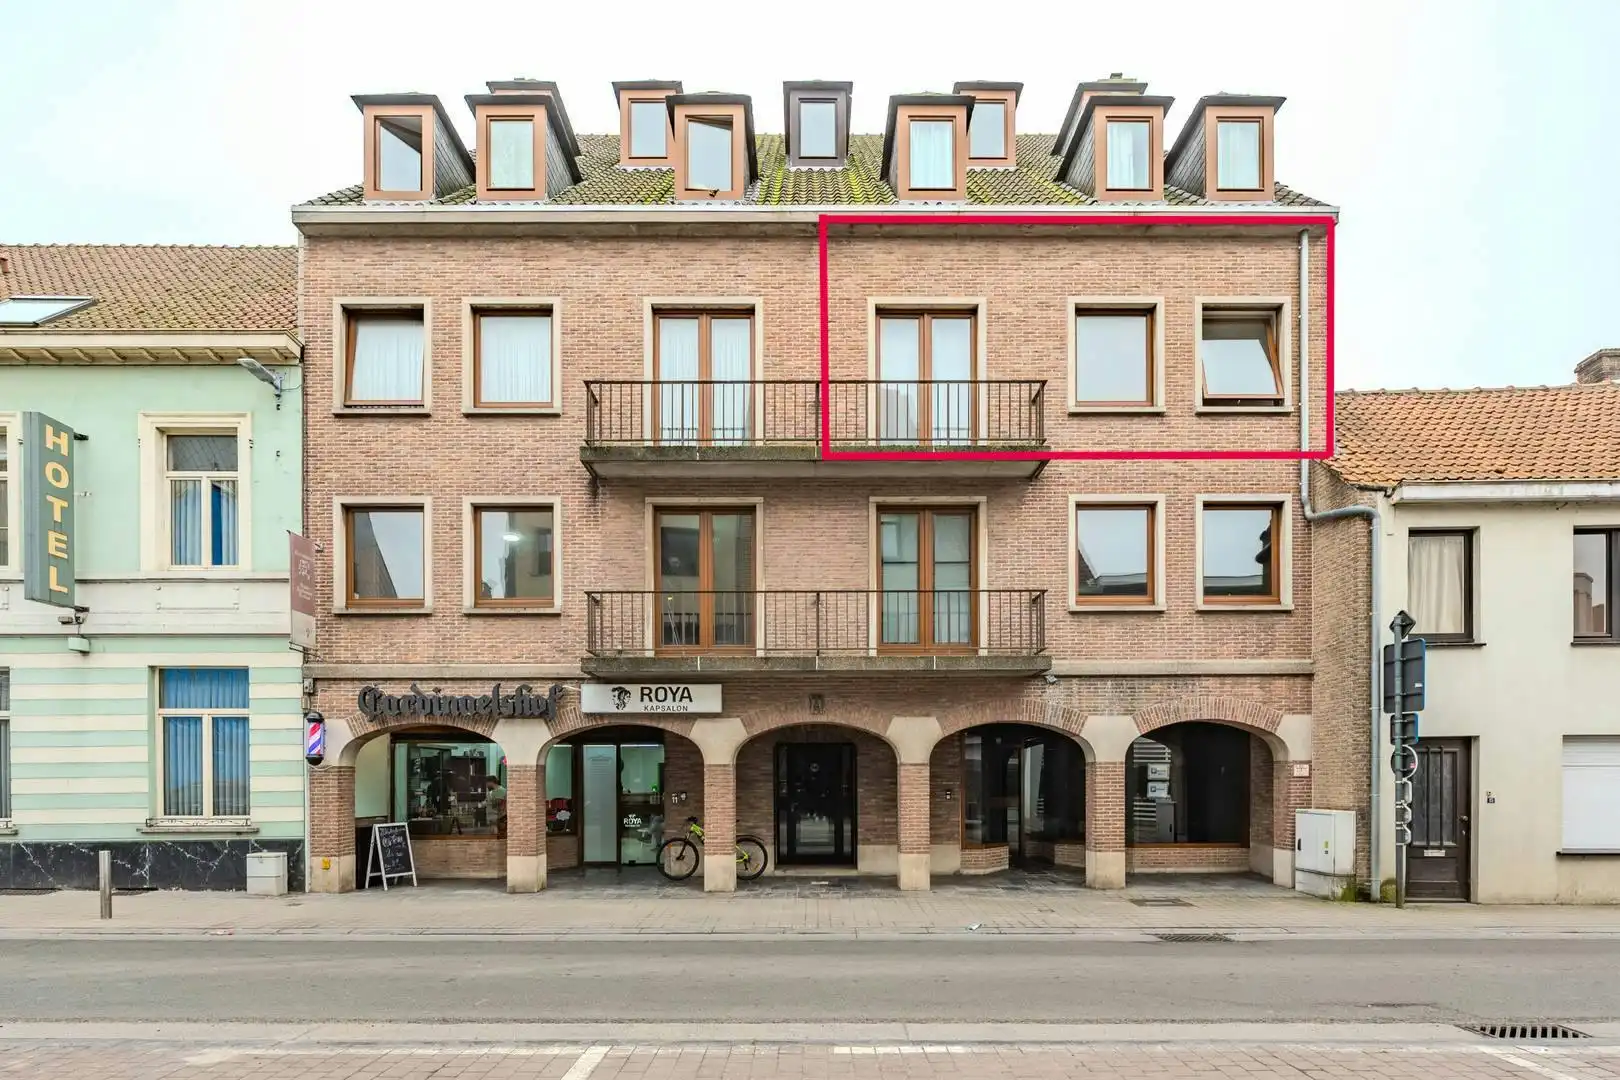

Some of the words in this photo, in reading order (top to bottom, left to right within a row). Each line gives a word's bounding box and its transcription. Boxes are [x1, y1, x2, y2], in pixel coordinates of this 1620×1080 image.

[45, 424, 70, 594] HOTEL
[640, 686, 693, 702] ROYA
[624, 817, 642, 825] ROYA
